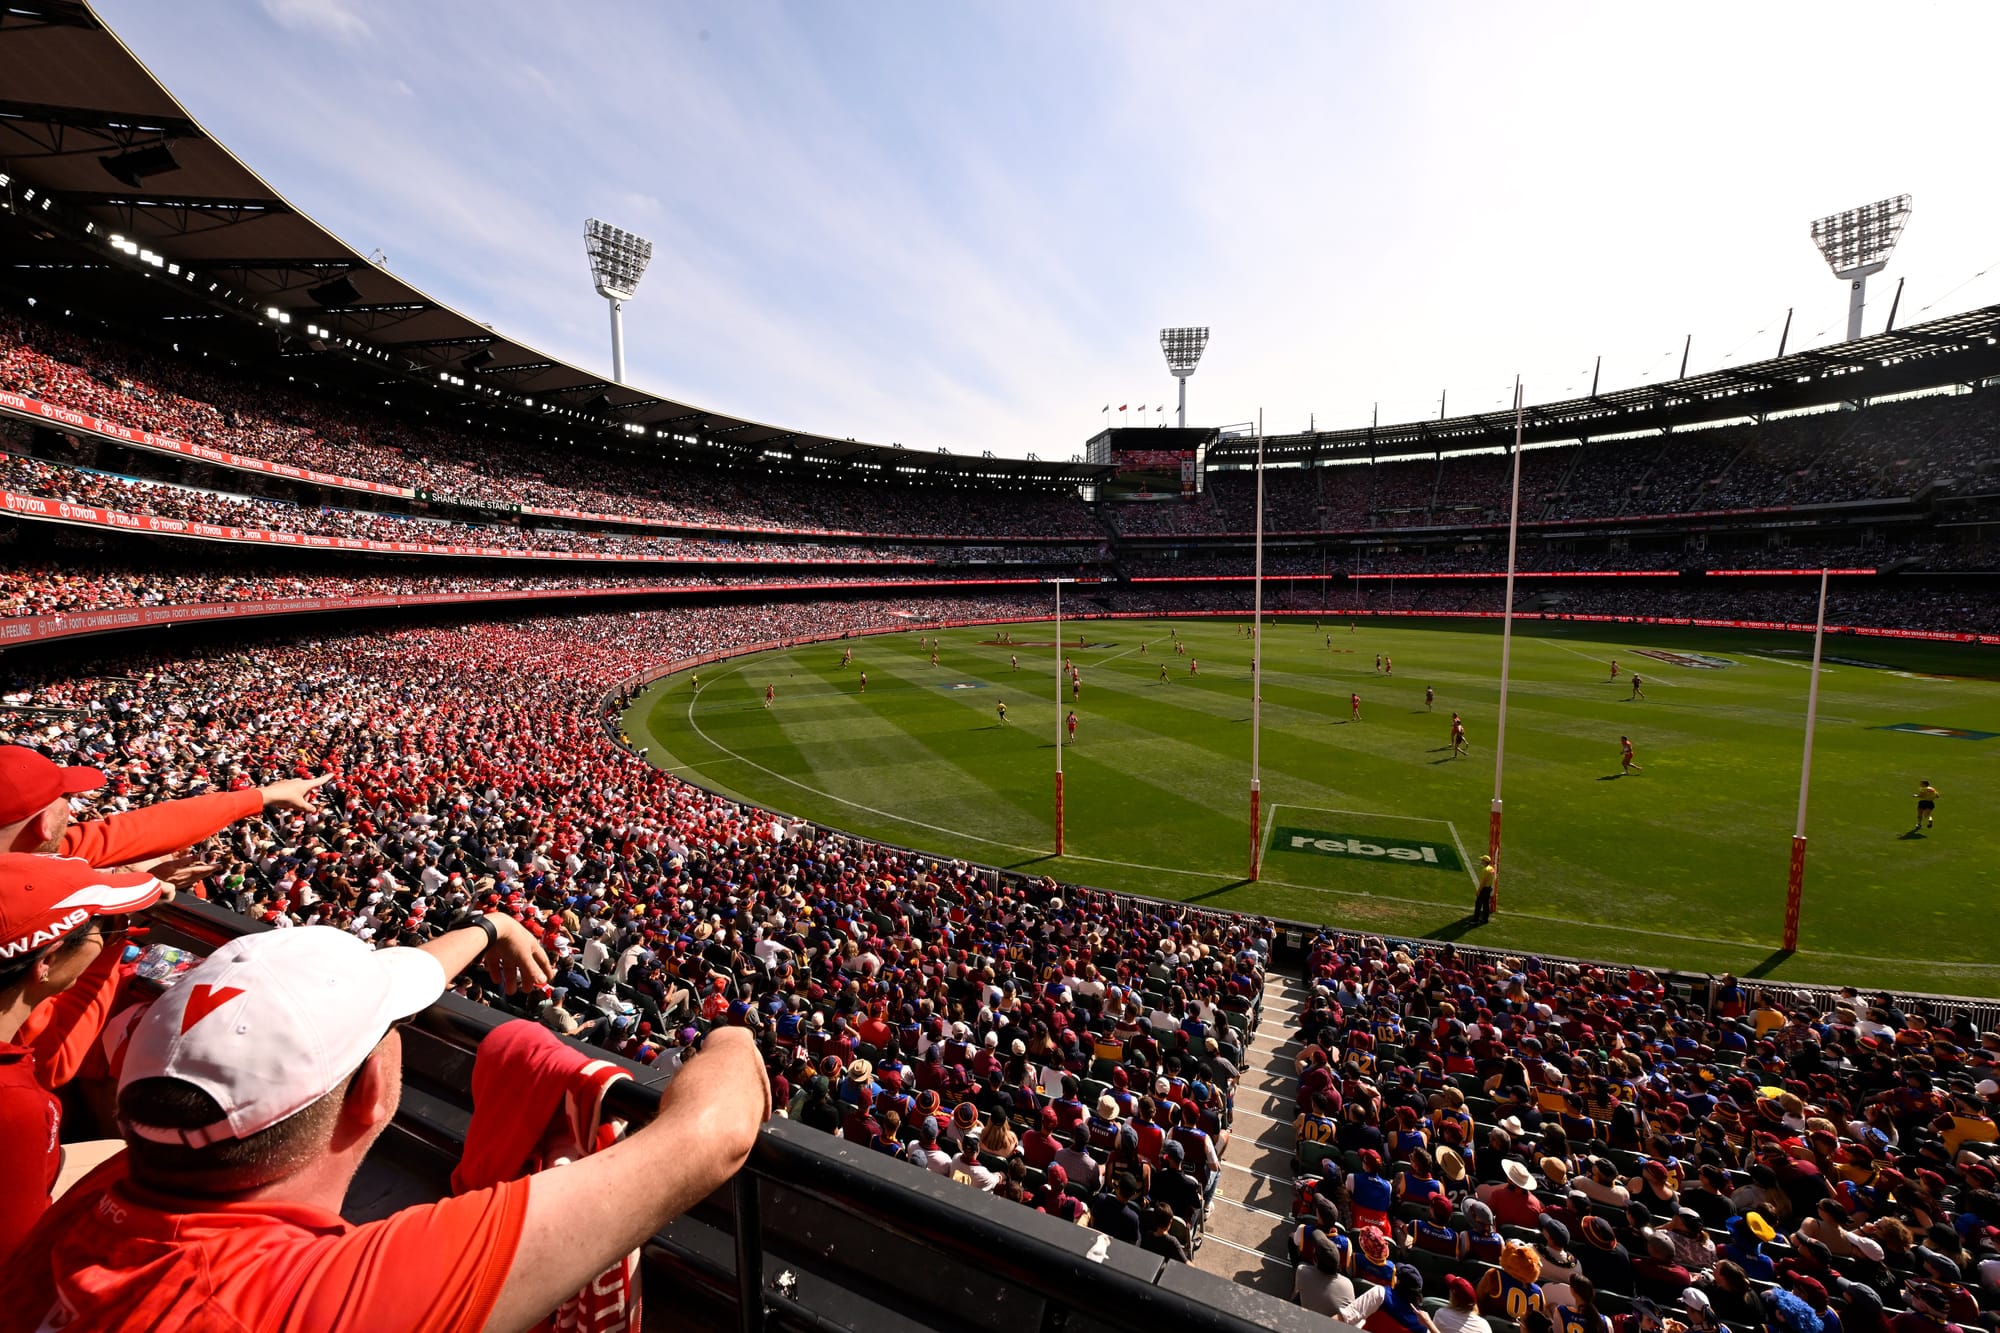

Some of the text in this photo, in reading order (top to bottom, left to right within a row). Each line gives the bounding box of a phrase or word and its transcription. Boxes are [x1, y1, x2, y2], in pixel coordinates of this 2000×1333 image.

[1852, 281, 1860, 290] 6
[614, 304, 622, 312] 4
[155, 438, 180, 450] TOYOTA
[201, 449, 223, 460] TOYOTA
[241, 458, 264, 469] TOYOTA
[280, 466, 300, 476] TOYOTA
[432, 492, 510, 511] SHANE WARNE STAND
[71, 506, 97, 520] TOYOTA
[202, 526, 222, 536] TOYOTA
[278, 534, 296, 543] TOYOTA
[97, 614, 113, 625] WHAT
[1290, 835, 1439, 864] rebel
[1377, 1025, 1395, 1043] 03
[1304, 1120, 1332, 1144] 02
